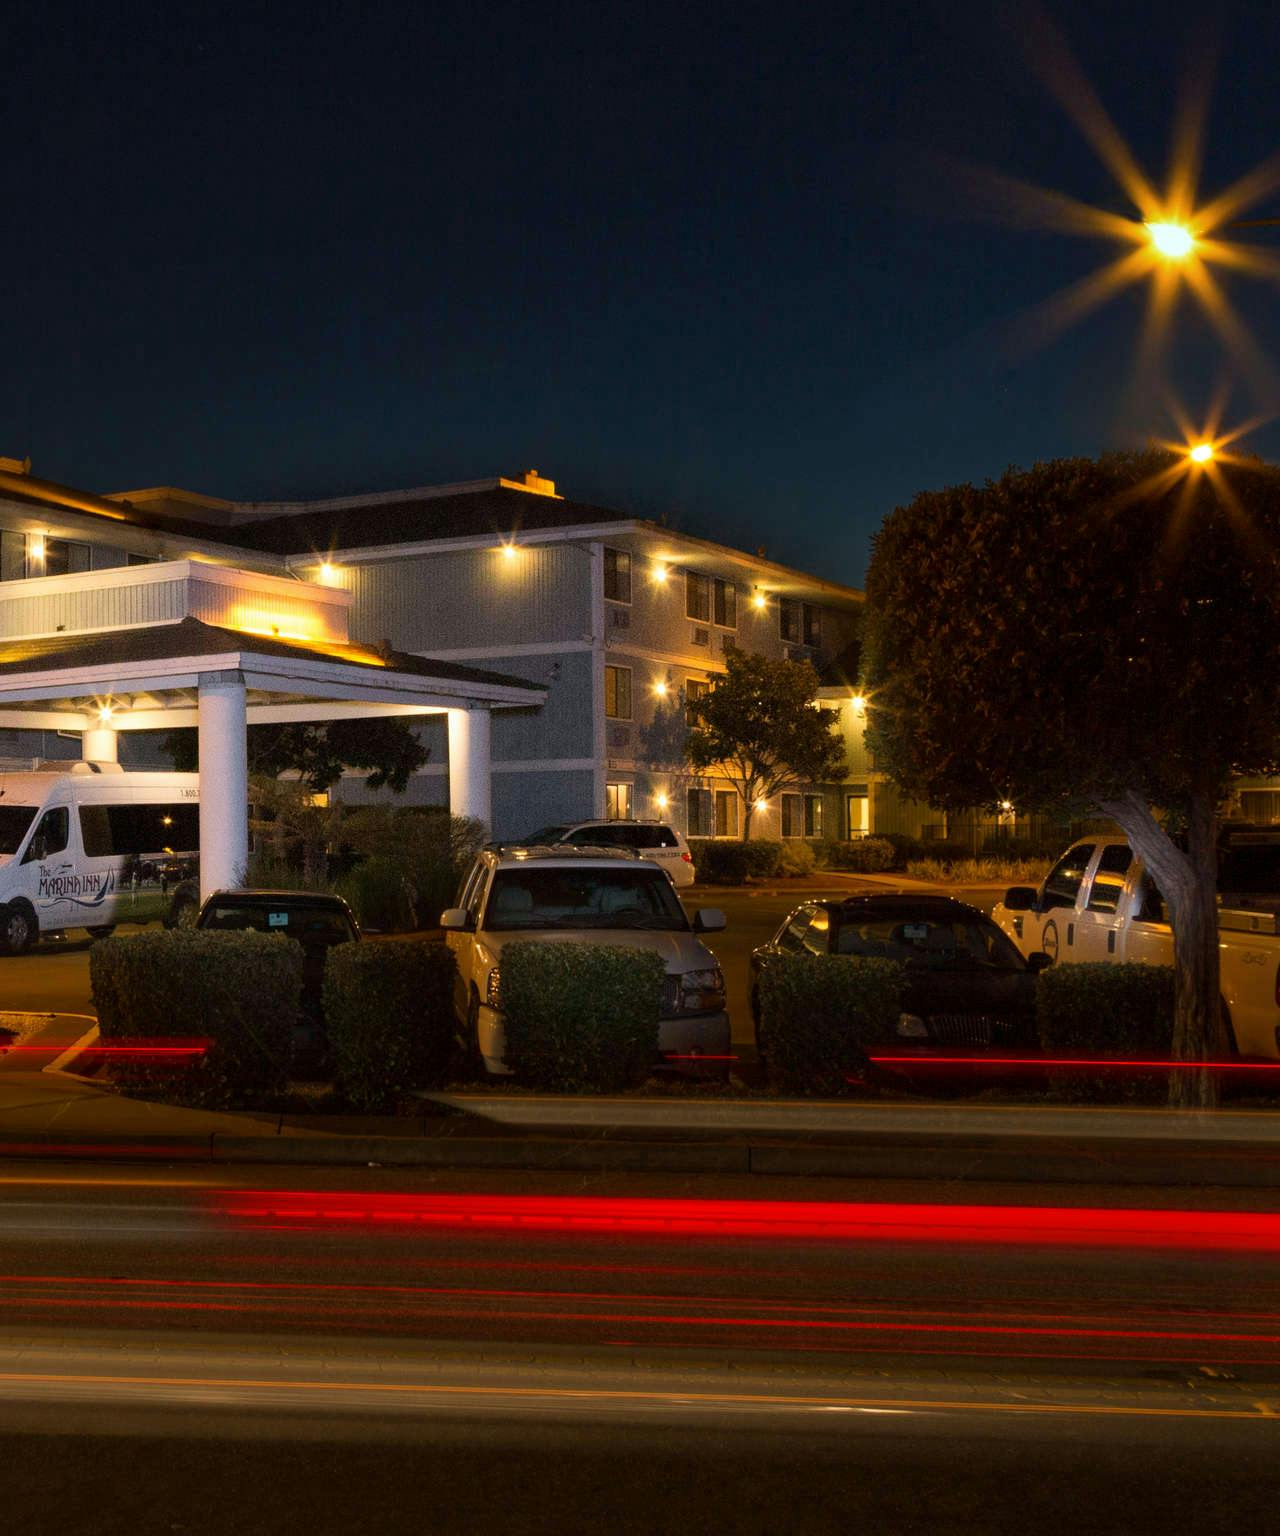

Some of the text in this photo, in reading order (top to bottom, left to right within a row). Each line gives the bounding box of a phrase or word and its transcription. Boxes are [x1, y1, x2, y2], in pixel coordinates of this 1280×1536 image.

[39, 864, 51, 877] The
[38, 875, 101, 898] MARINA INN
